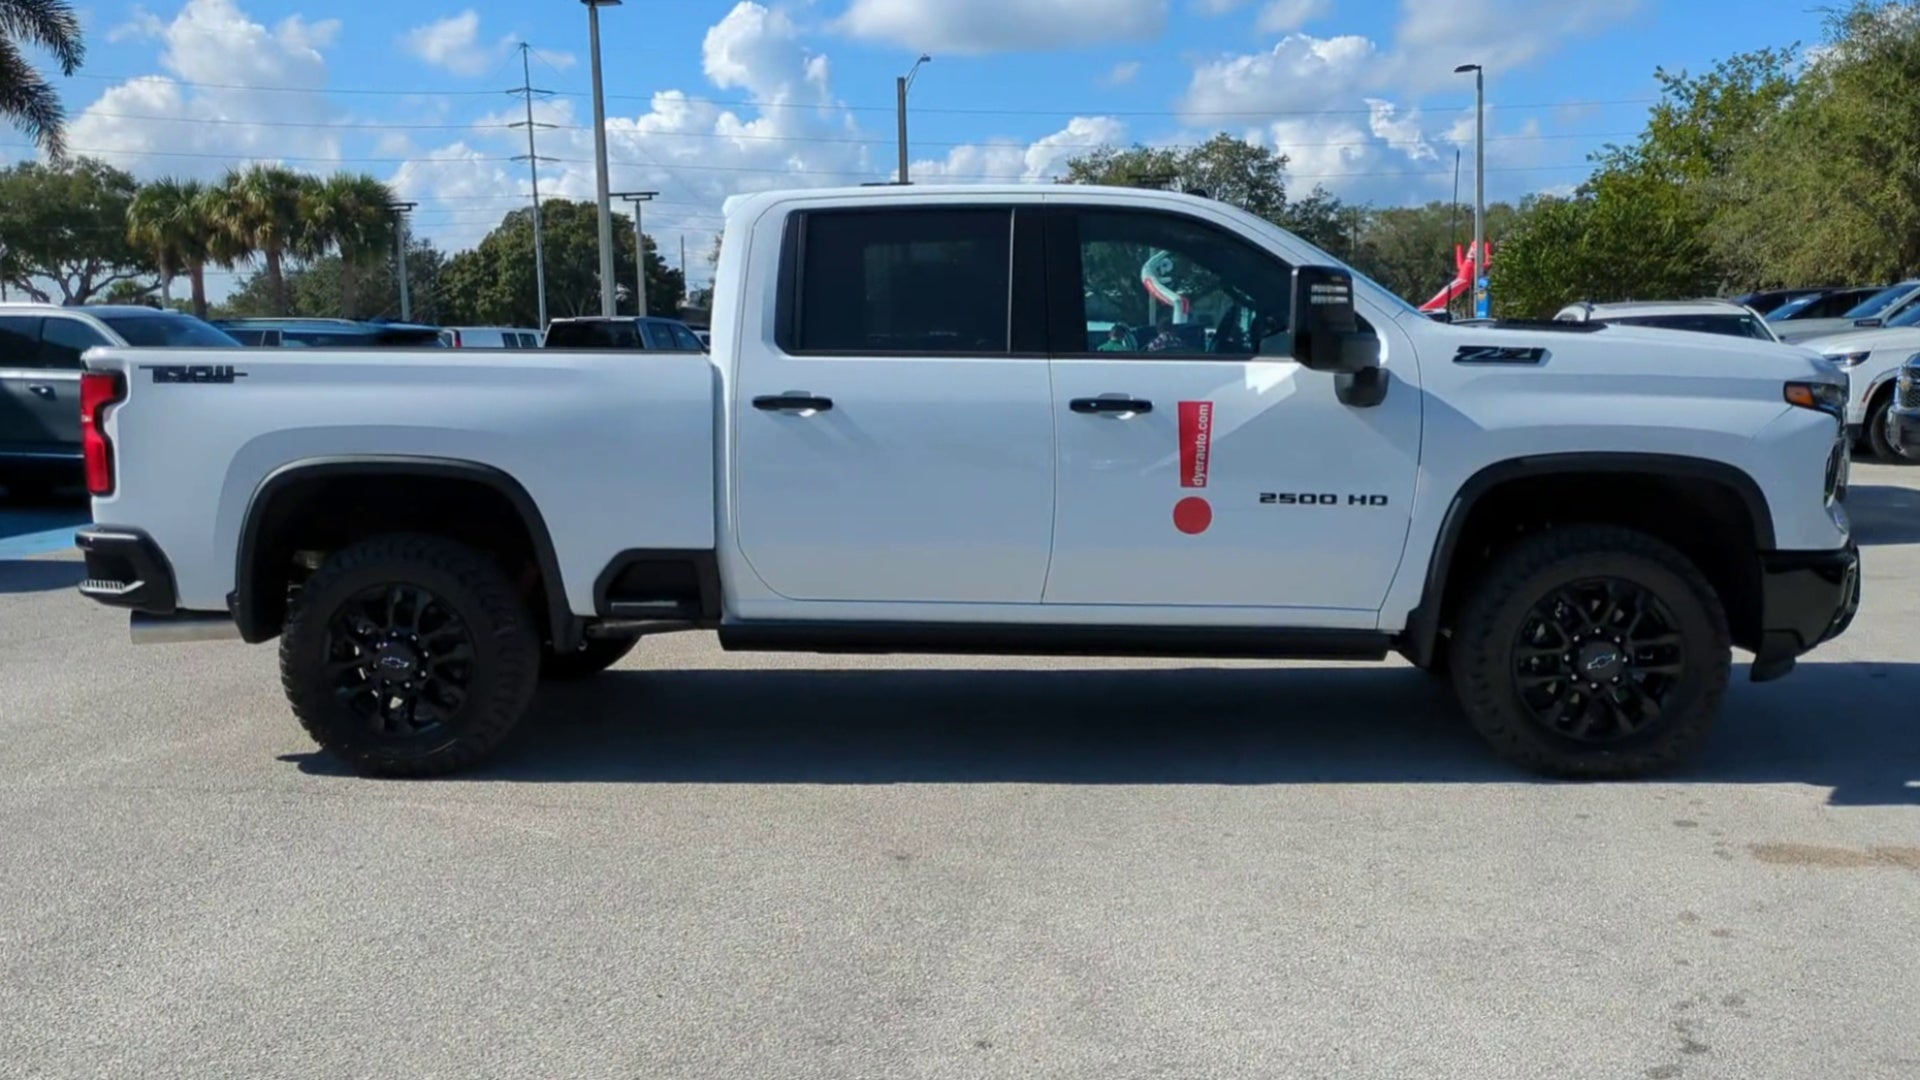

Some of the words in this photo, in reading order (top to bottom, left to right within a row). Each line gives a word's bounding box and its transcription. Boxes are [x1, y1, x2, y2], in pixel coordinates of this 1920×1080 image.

[1191, 404, 1210, 487] dyerauto.com
[1259, 492, 1338, 505] 2500
[1347, 494, 1388, 506] HD
